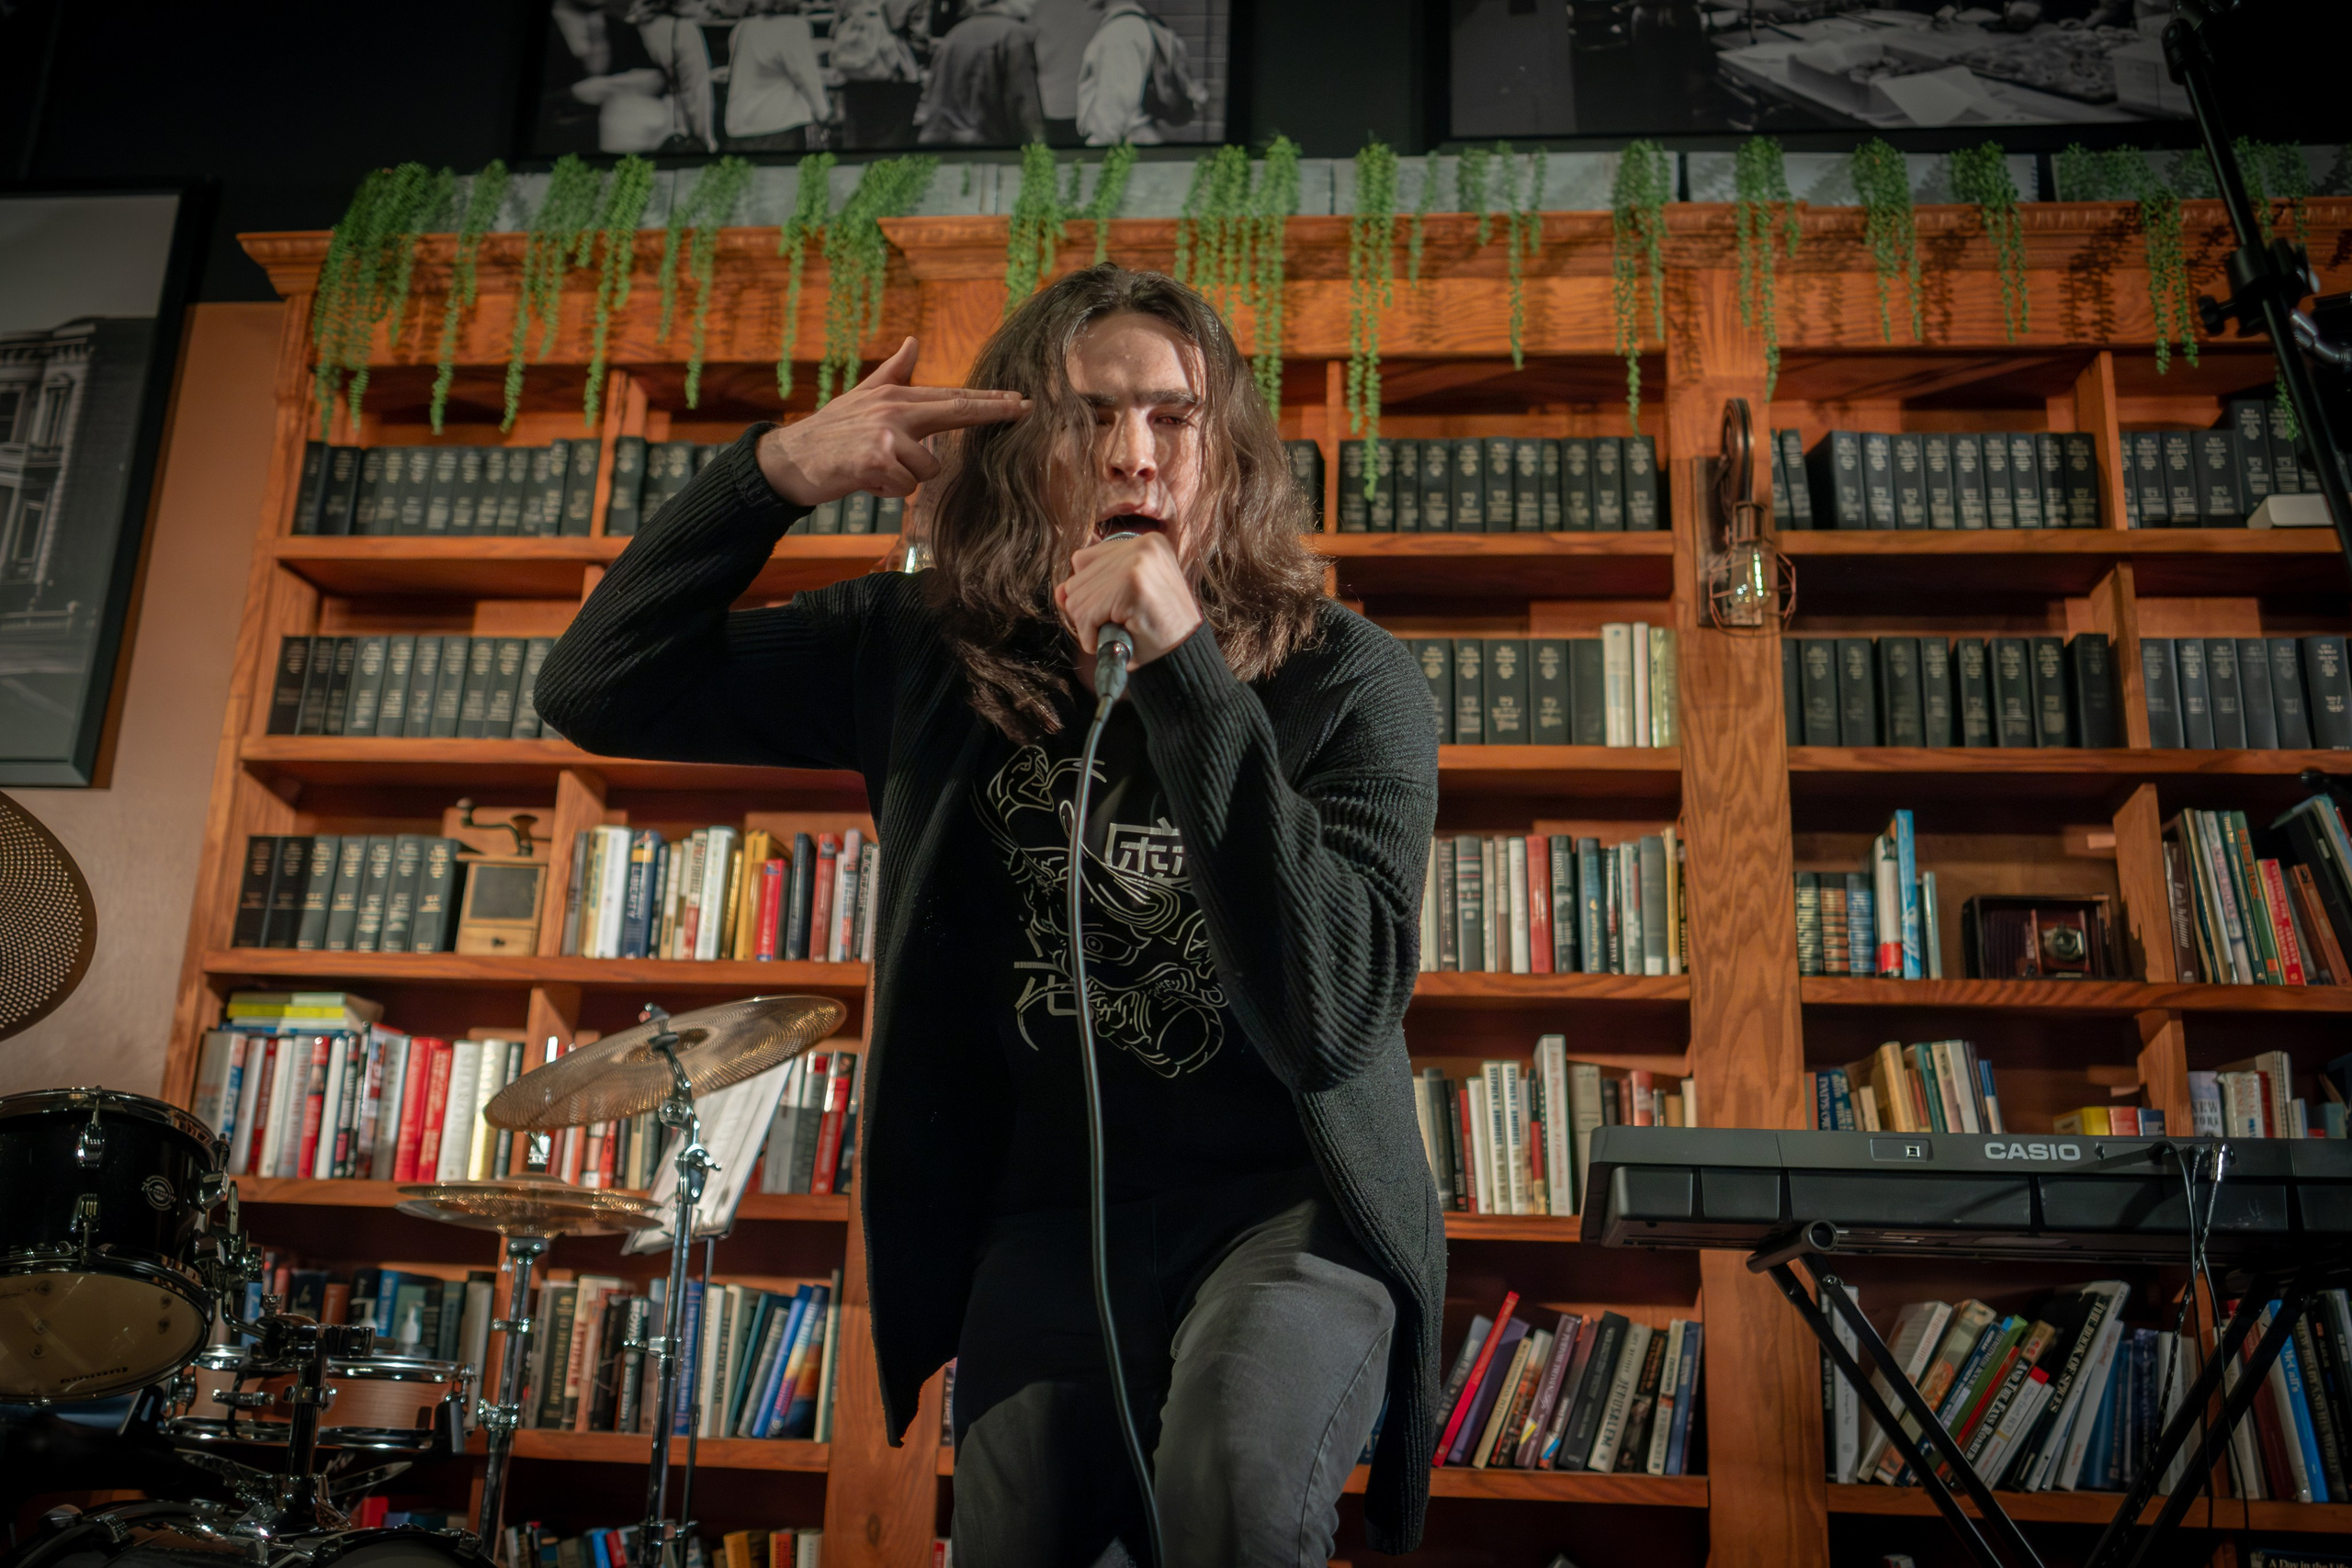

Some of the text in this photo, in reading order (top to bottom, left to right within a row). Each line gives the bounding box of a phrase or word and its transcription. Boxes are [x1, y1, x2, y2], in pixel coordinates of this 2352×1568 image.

[628, 864, 642, 919] LIBERTY
[1489, 1066, 1499, 1100] STEPHEN
[1508, 1066, 1517, 1100] STEPHEN
[1492, 1110, 1501, 1145] AMBROSE
[1510, 1111, 1520, 1145] AMBROSE
[1984, 1142, 2081, 1161] CASIO
[2088, 1301, 2107, 1325] THE
[2075, 1325, 2095, 1356] BOOK
[2066, 1356, 2081, 1373] OF
[1600, 1379, 1630, 1448] JERUSALEM
[1965, 1359, 2030, 1461] AND THE FANS ROARED
[2323, 1433, 2338, 1473] WORLD
